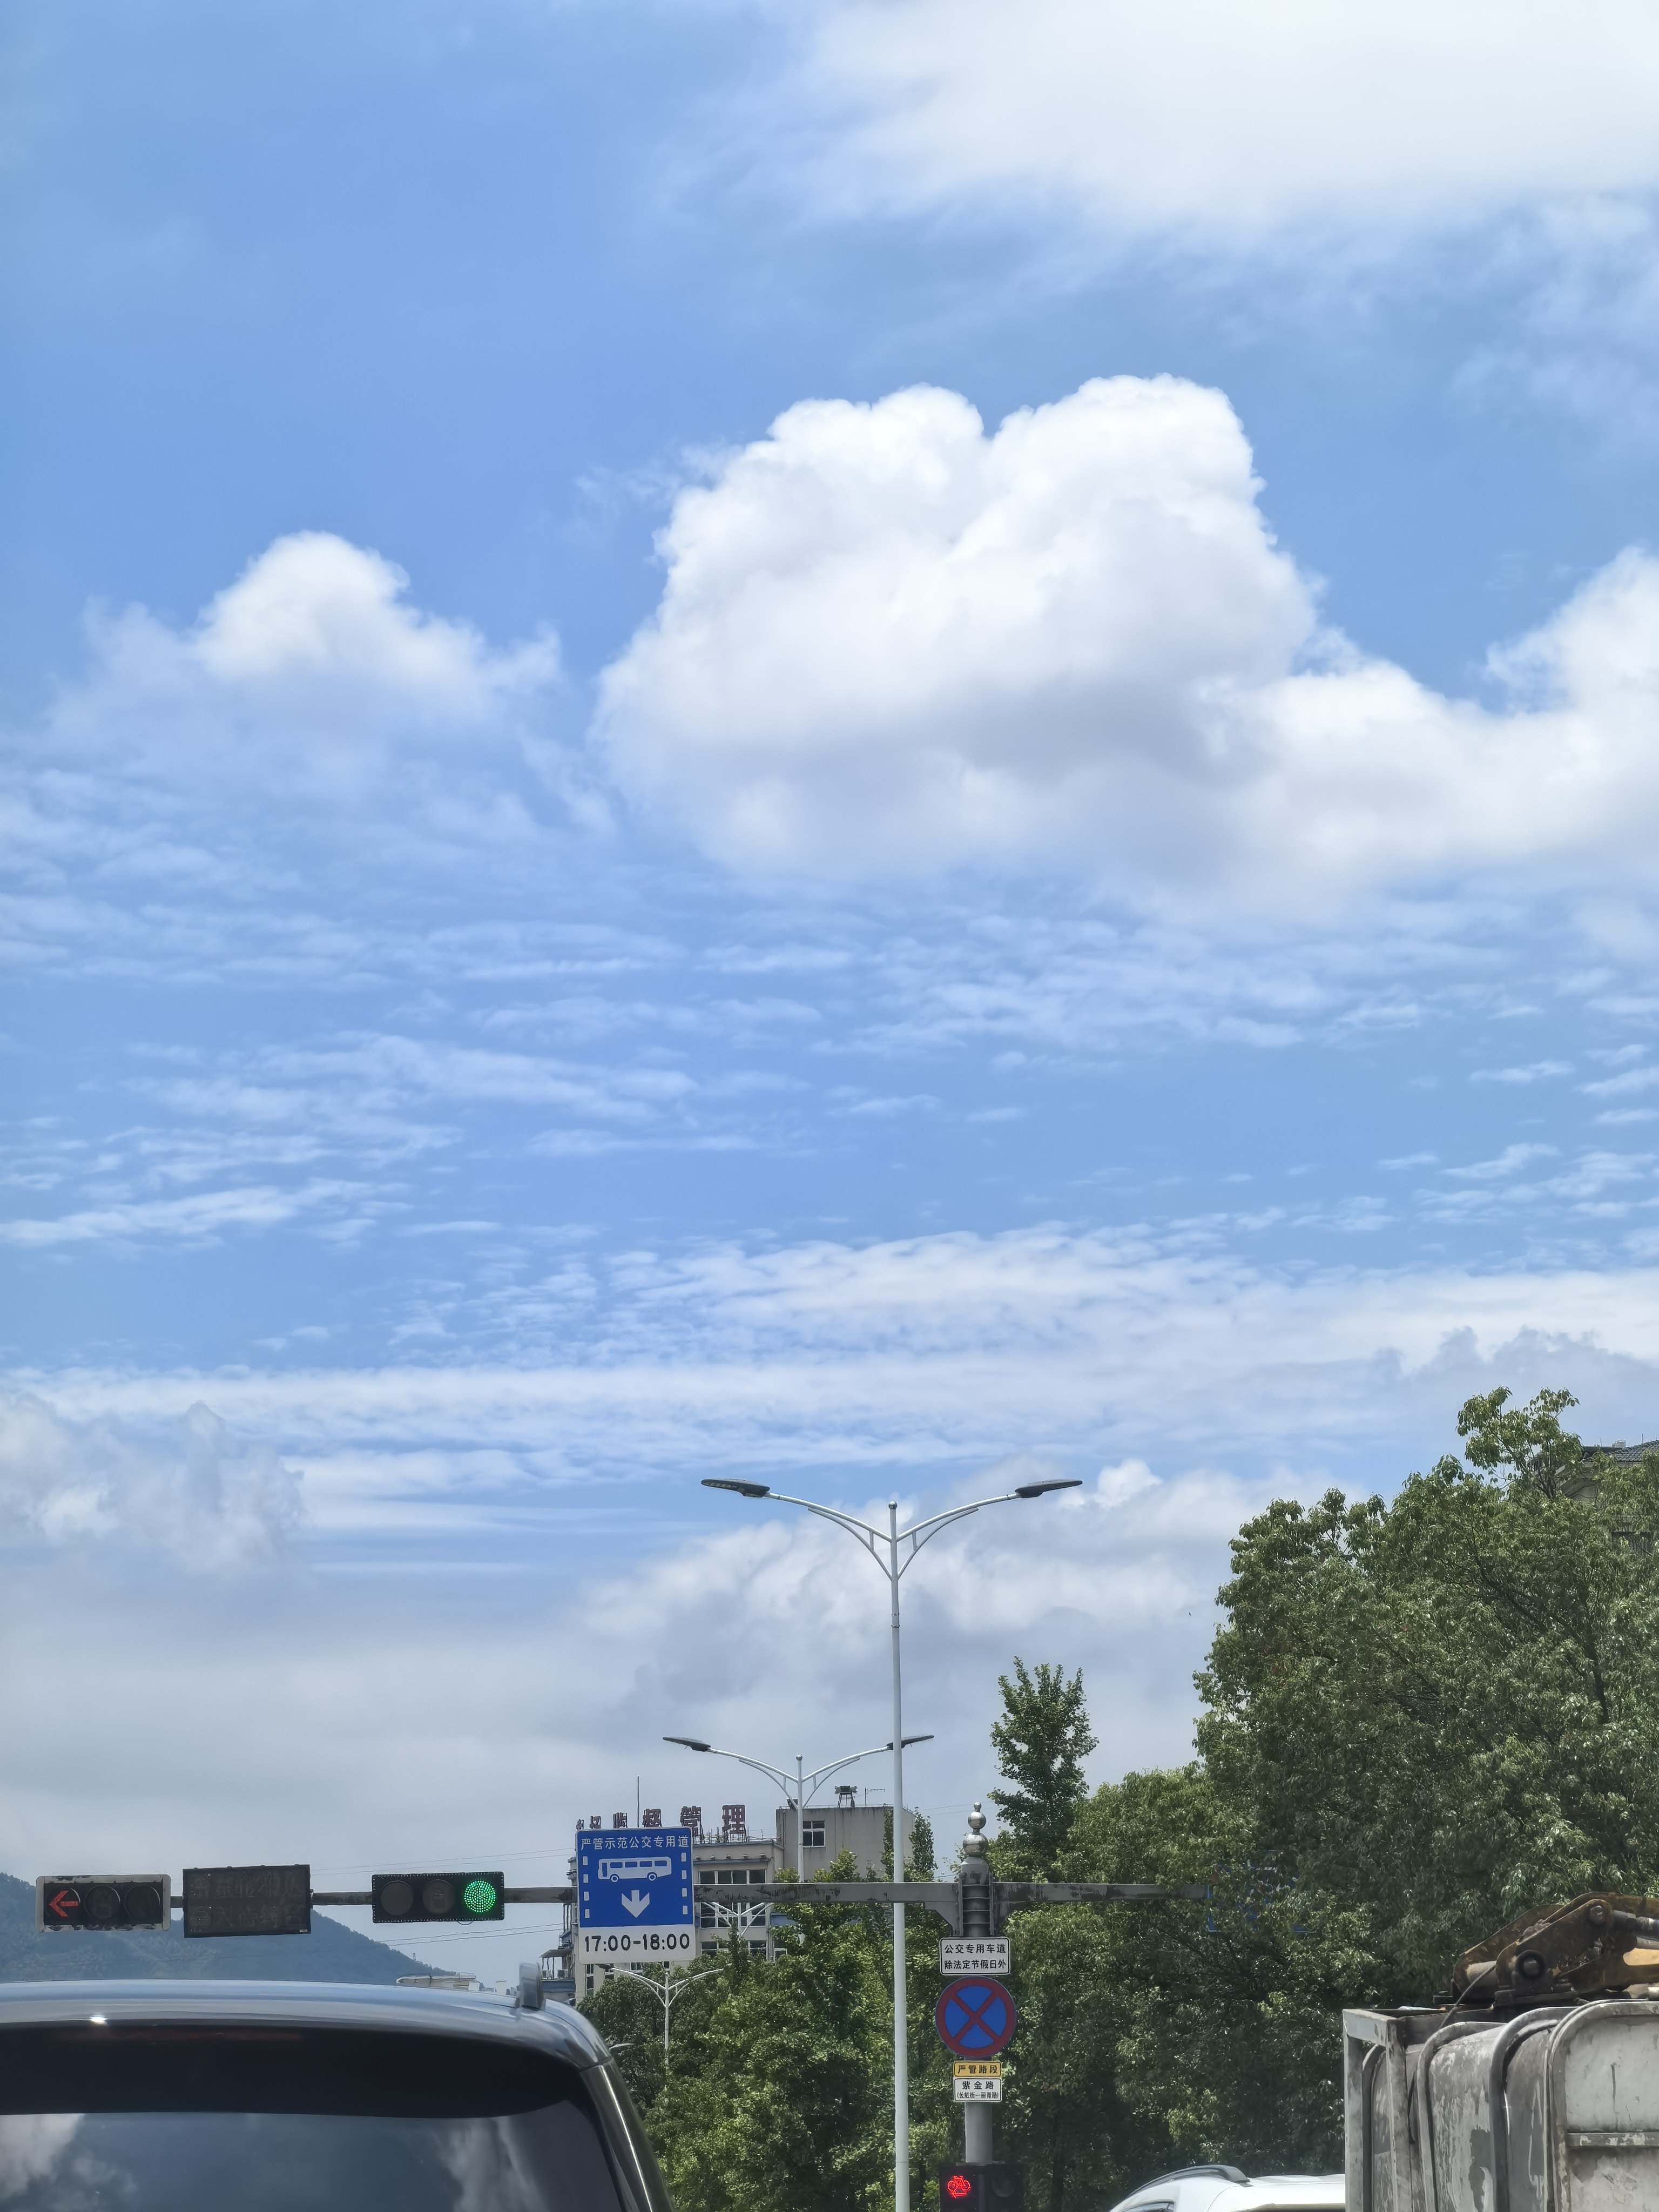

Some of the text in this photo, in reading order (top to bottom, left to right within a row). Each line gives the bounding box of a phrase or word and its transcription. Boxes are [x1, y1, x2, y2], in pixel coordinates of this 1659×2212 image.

[581, 1835, 689, 1850] 严管示范公交专用道
[585, 1933, 690, 1952] 17:00-18:00
[945, 1944, 1006, 1954] 公交专用车道
[945, 1960, 1006, 1970] 除法定节假日外
[957, 2065, 998, 2074] 严管路段
[962, 2080, 994, 2089] 紫金路
